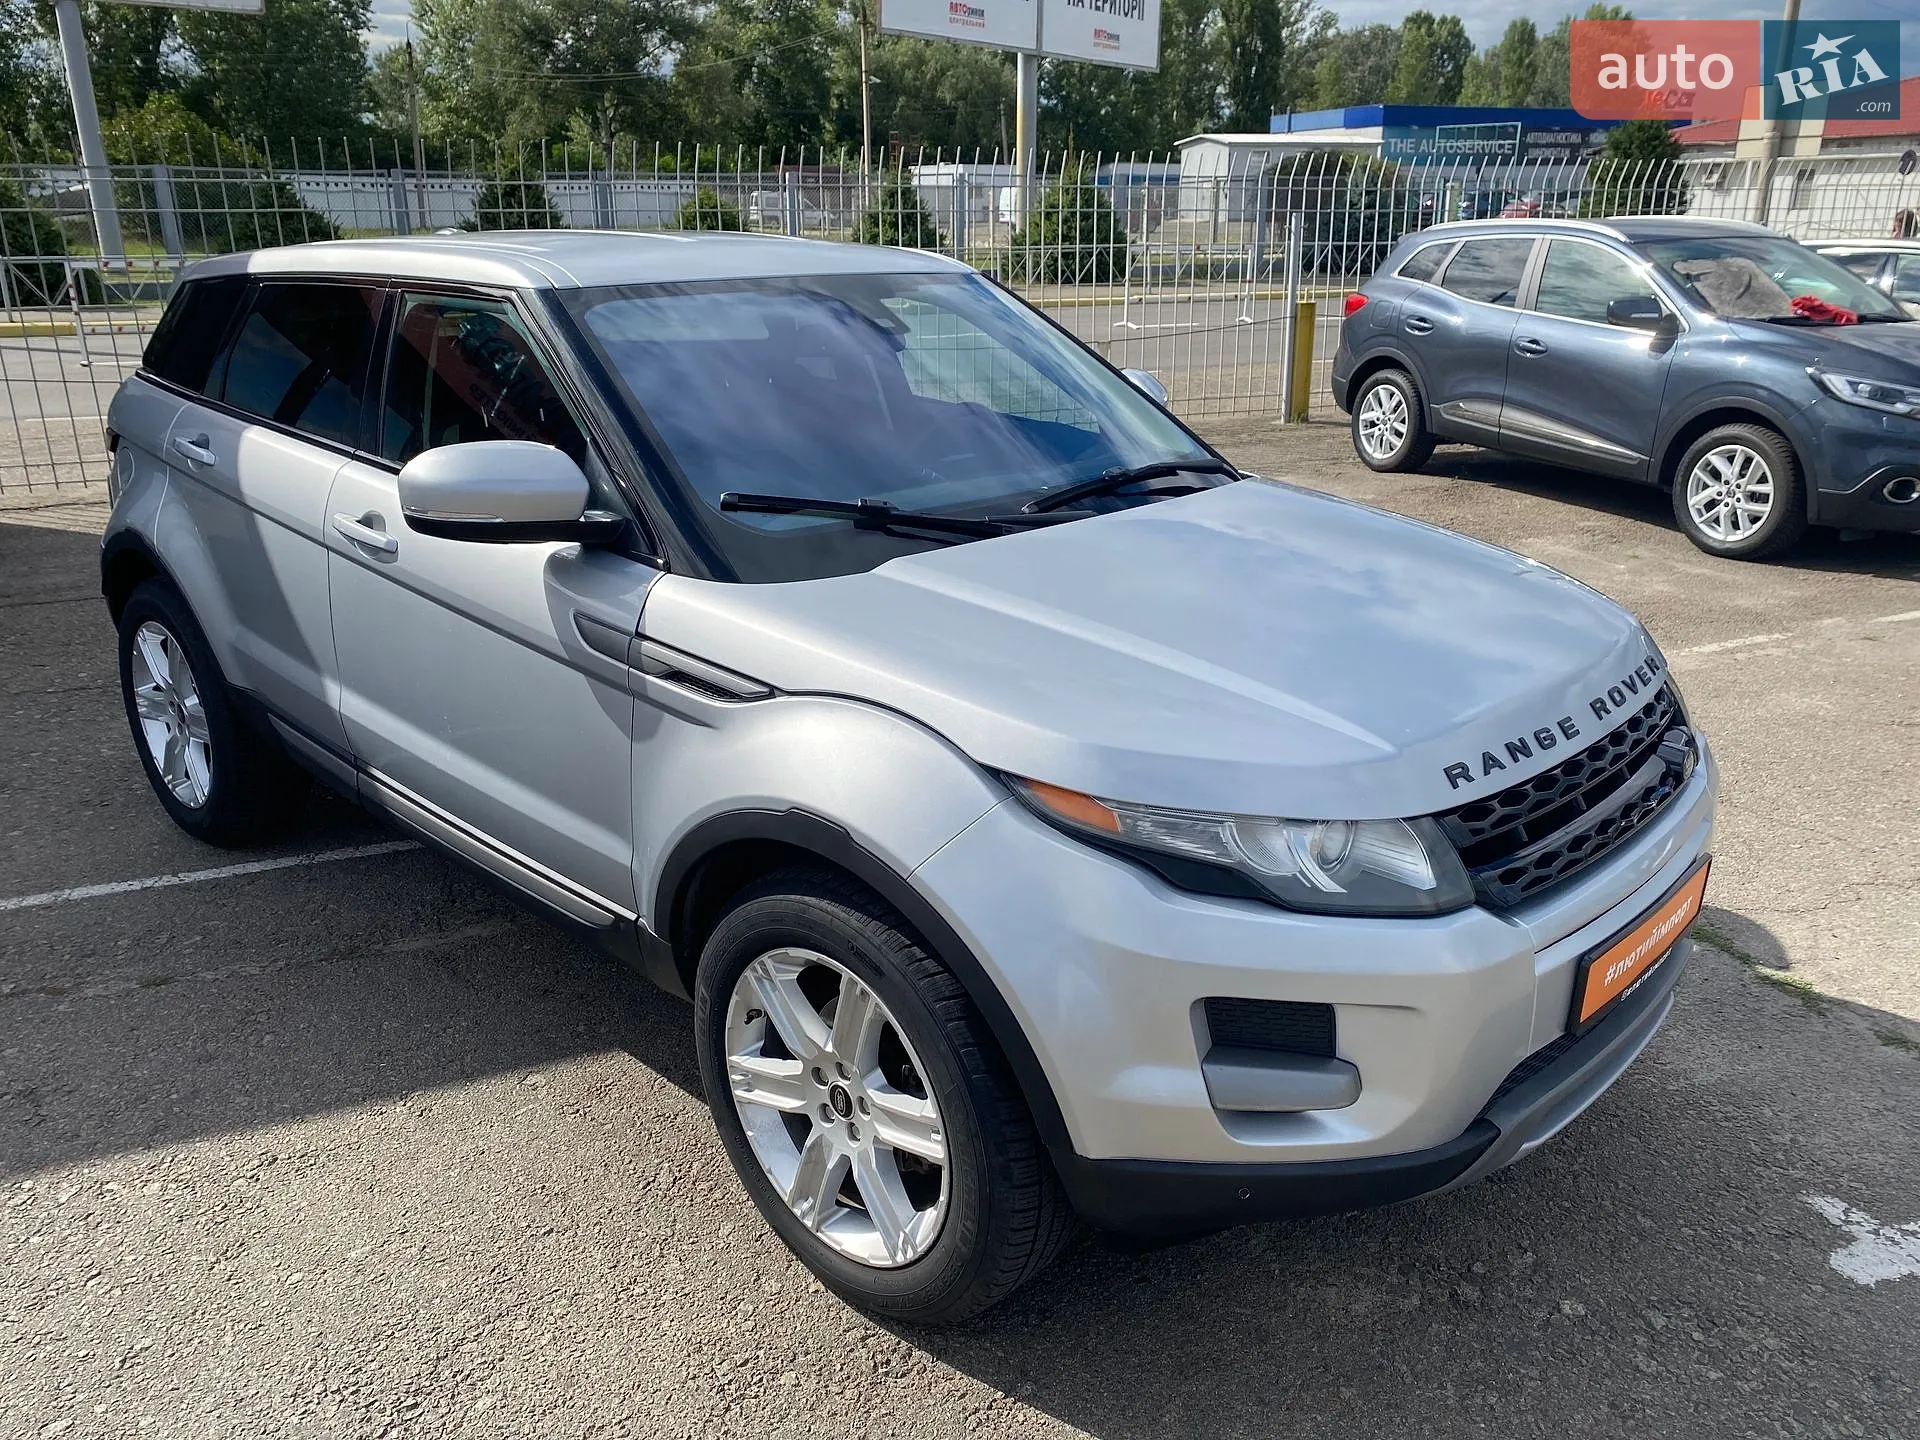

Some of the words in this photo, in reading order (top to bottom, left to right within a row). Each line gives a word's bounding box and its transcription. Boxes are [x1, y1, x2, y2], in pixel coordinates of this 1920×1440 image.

[1389, 139, 1416, 153] THE
[1419, 139, 1513, 154] AUTOSERVICE
[1442, 716, 1581, 790] RANGE
[1589, 655, 1661, 720] ROVER
